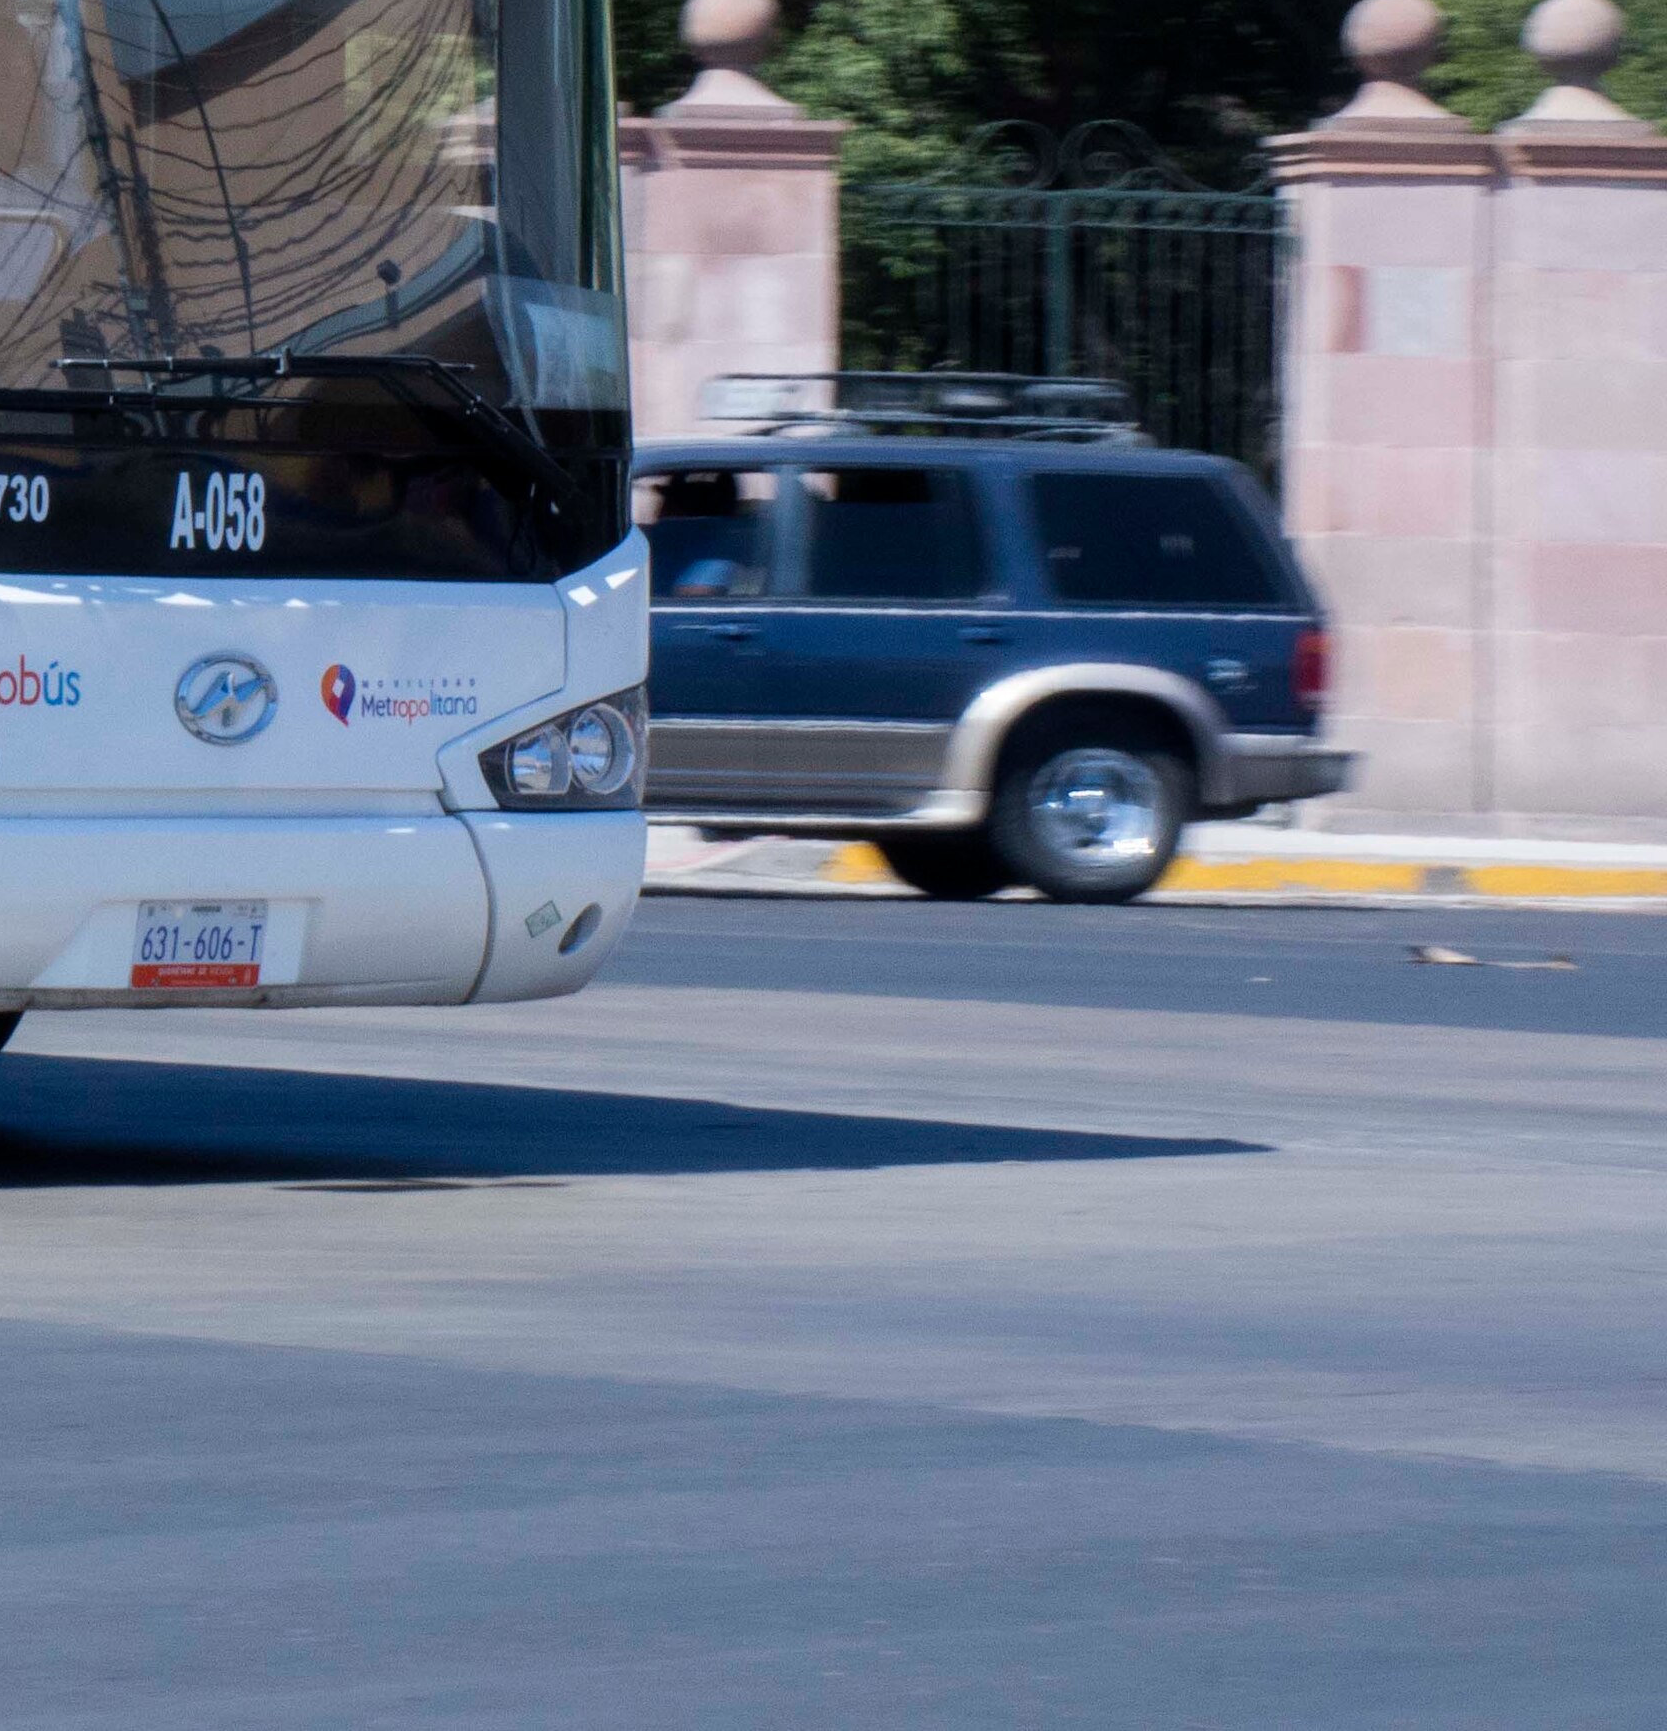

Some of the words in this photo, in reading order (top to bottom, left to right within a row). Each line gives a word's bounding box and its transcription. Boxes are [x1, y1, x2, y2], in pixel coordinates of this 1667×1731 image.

[169, 471, 266, 552] A-058
[361, 689, 477, 725] Metropolitana
[140, 924, 262, 961] 631-606-T
